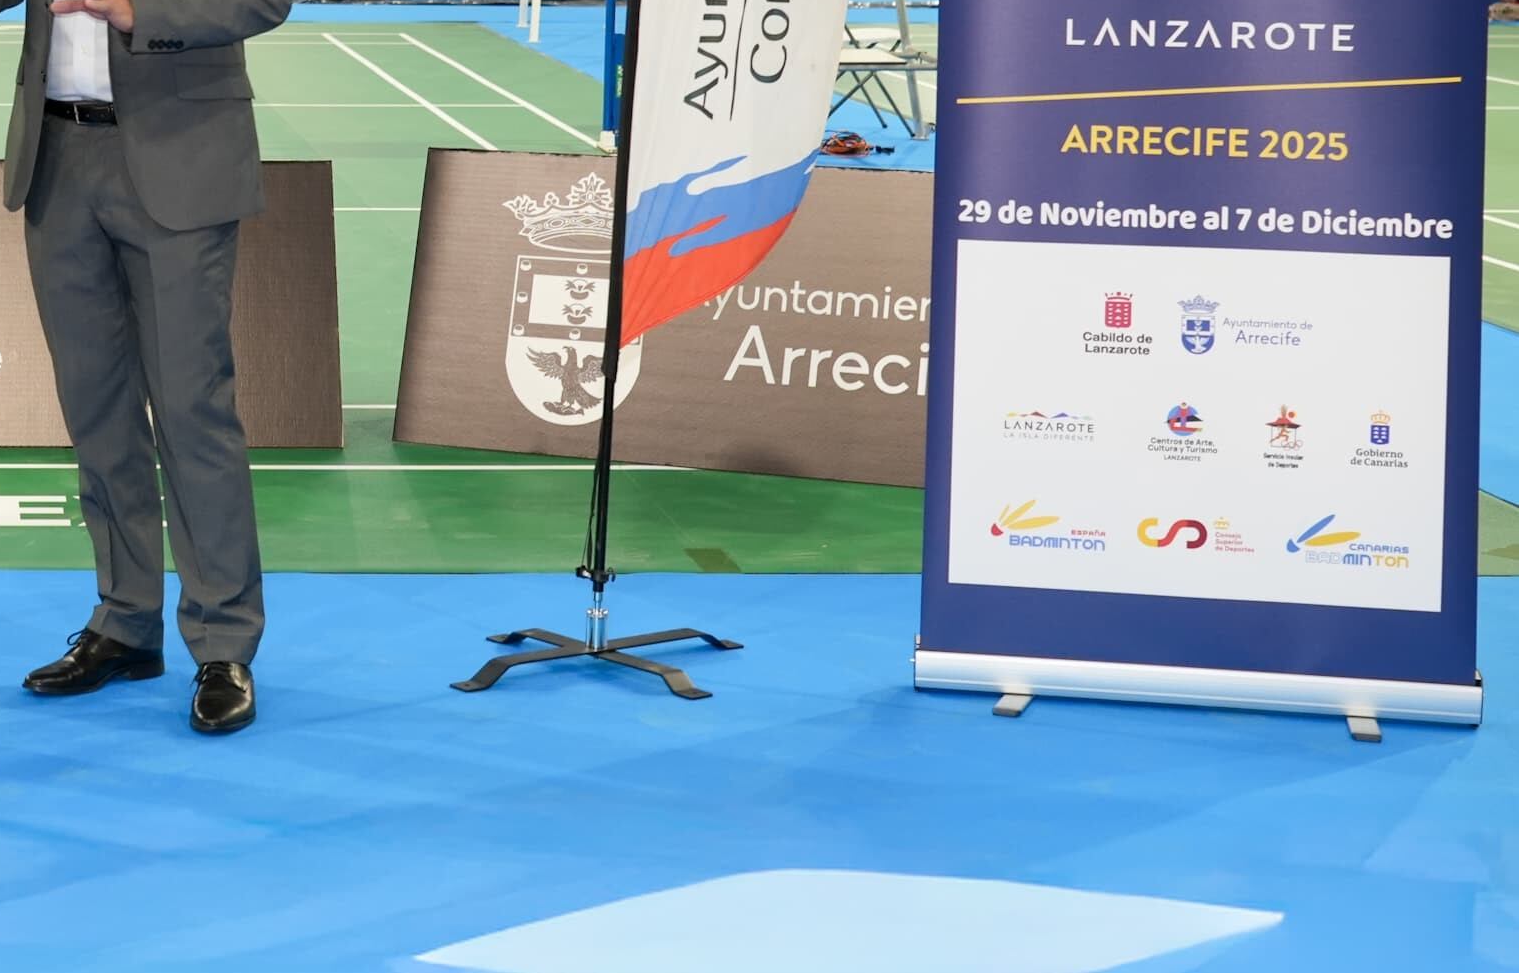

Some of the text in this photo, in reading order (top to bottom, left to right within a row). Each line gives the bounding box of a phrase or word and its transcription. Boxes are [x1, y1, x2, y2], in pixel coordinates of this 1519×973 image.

[1065, 18, 1355, 52] LANZAROTE
[1060, 125, 1349, 161] ARRECIFE 2025
[958, 199, 1454, 239] 29 de Noviembre al 7 de Diciembre
[704, 280, 931, 322] yuntamie
[1223, 316, 1313, 330] Ayuntamiento de
[1082, 331, 1153, 344] Cabildo de
[1235, 330, 1301, 346] Arrecife
[1084, 343, 1150, 356] Lanzarote
[723, 324, 930, 396] Arreci
[1004, 419, 1095, 434] LANZAROTE
[1150, 437, 1183, 446] Centros
[1184, 438, 1194, 446] de
[1147, 444, 1178, 453] Cultura
[1186, 445, 1218, 454] Turismo
[1356, 448, 1404, 458] Gobierno
[1350, 457, 1409, 468] de Canarias
[1071, 528, 1106, 537] ESPAÑA
[1009, 534, 1106, 551] BADMINTON
[1349, 543, 1409, 554] CANARIAS
[1305, 550, 1409, 569] BADMINTON
